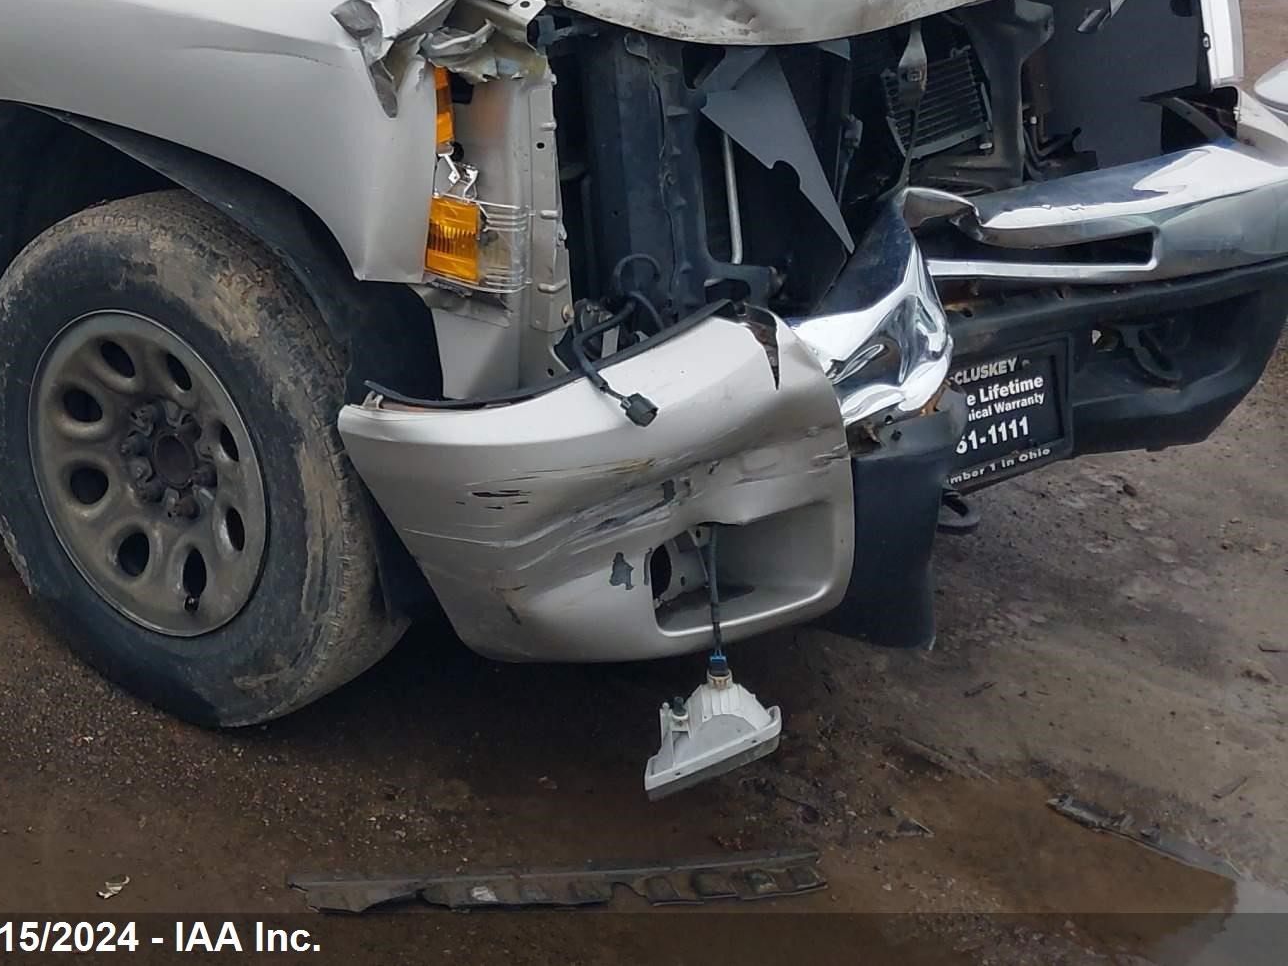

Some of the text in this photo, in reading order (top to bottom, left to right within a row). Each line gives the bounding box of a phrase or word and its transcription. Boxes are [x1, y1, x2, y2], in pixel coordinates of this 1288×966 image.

[952, 357, 1018, 386] CLUSKEY
[979, 375, 1044, 403] Lifetime
[993, 392, 1045, 414] Warranty
[955, 415, 1030, 455] 61-1111
[948, 466, 985, 485] mber
[1018, 447, 1051, 462] Ohio
